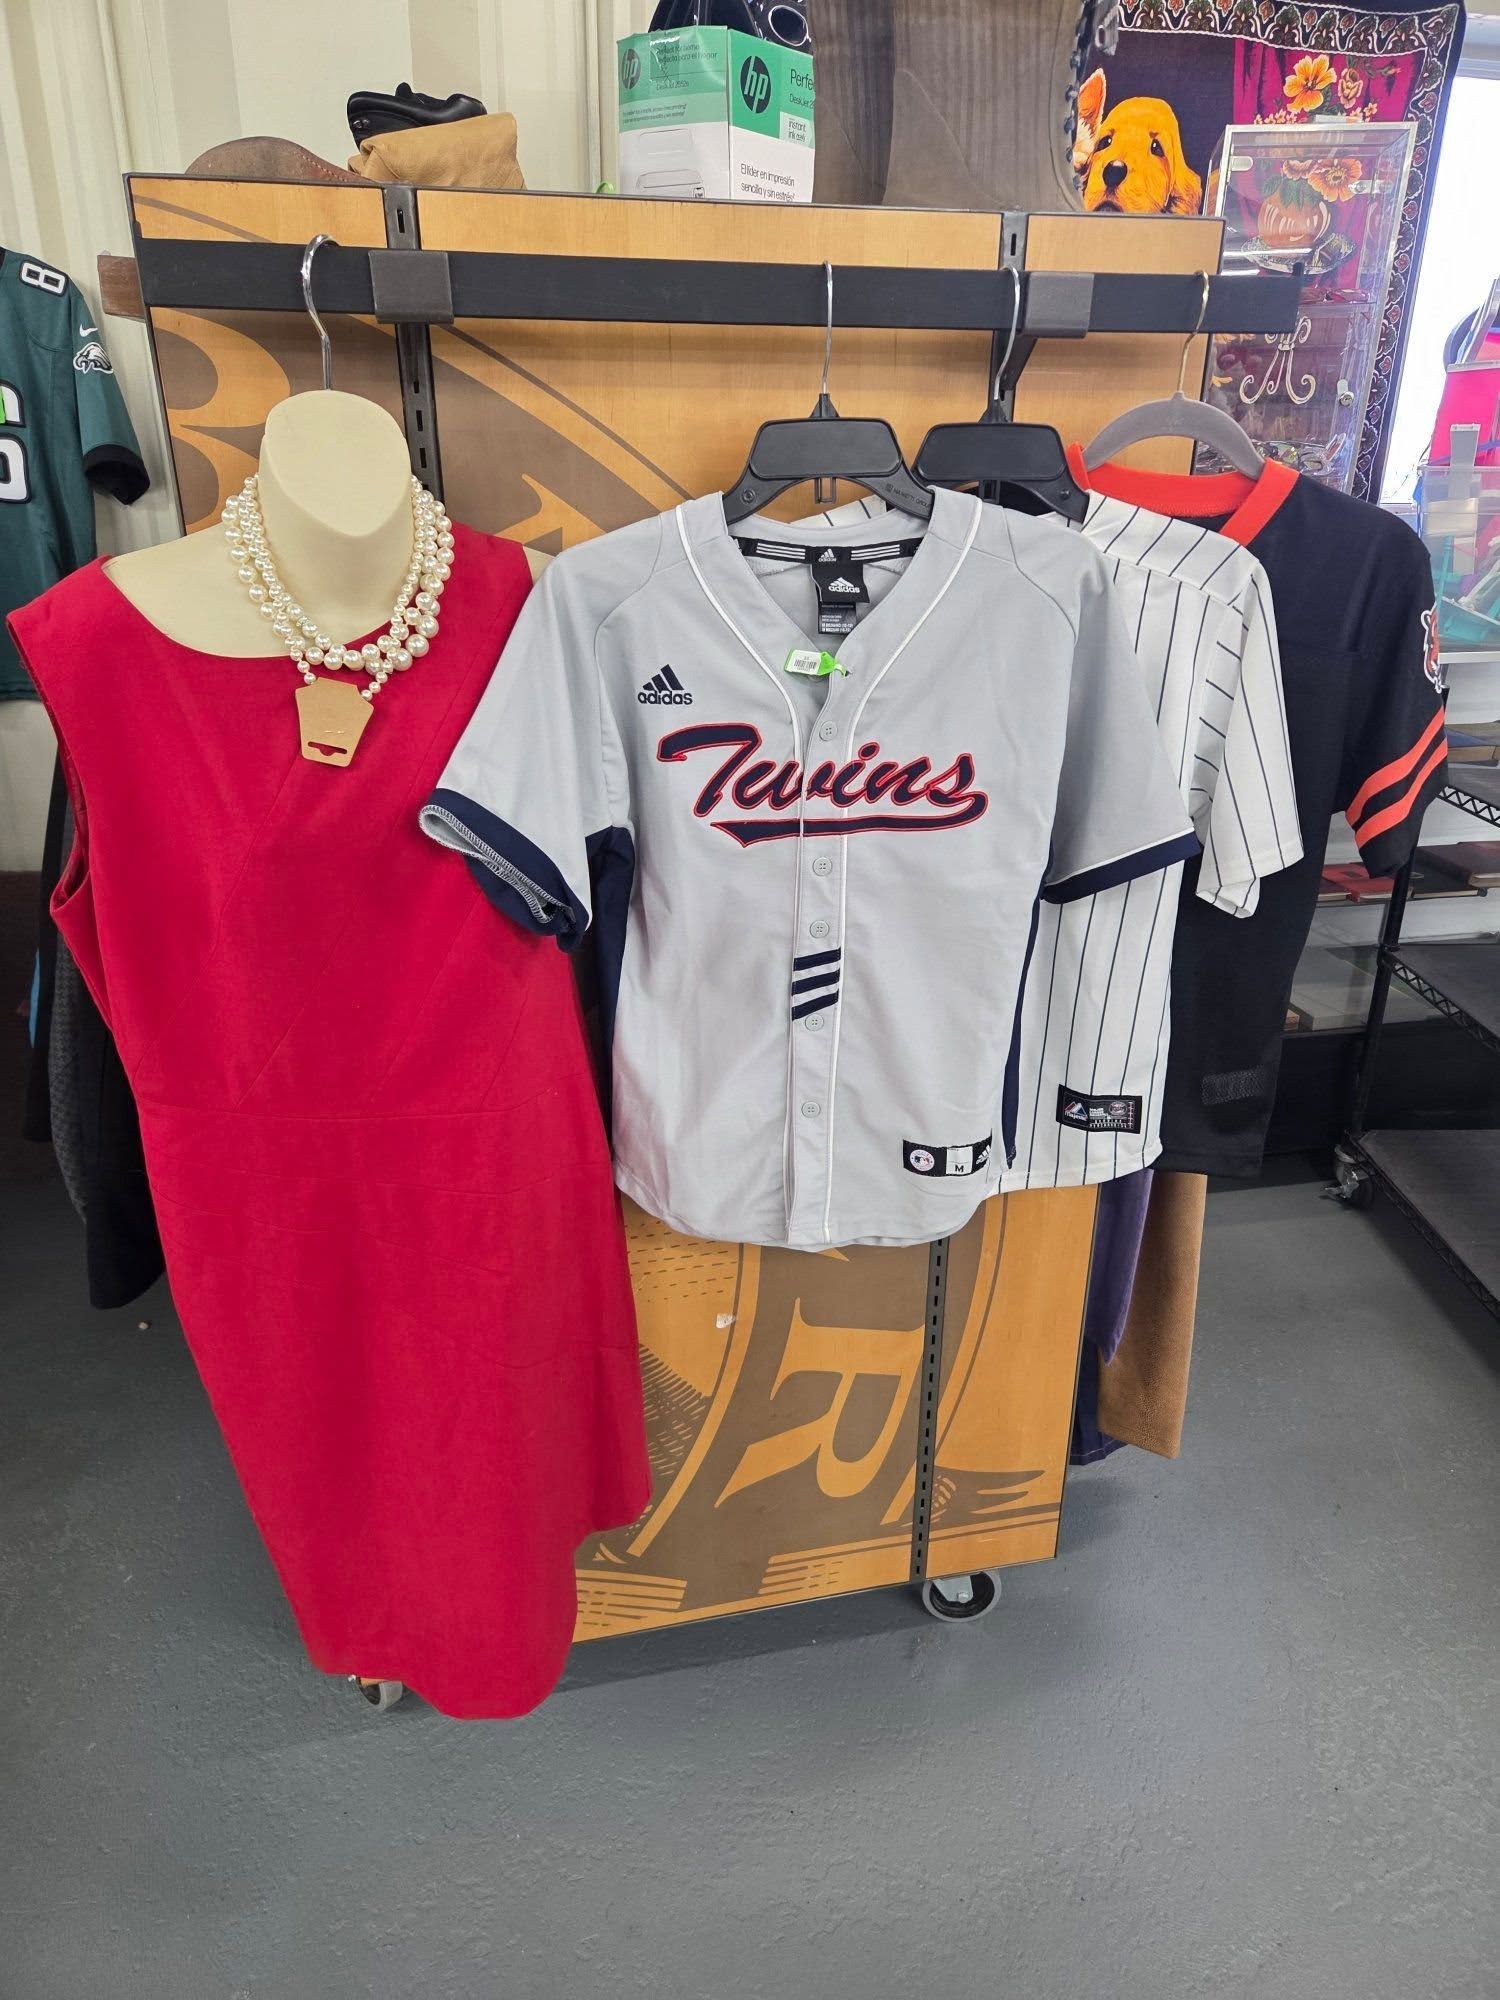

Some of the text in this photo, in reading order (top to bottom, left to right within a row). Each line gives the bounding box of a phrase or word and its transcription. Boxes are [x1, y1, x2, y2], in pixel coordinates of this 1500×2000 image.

[623, 49, 640, 90] hp
[743, 55, 770, 113] hp
[828, 584, 861, 594] adidas
[637, 689, 693, 706] adidas
[657, 722, 989, 847] Twins
[954, 1164, 965, 1173] M
